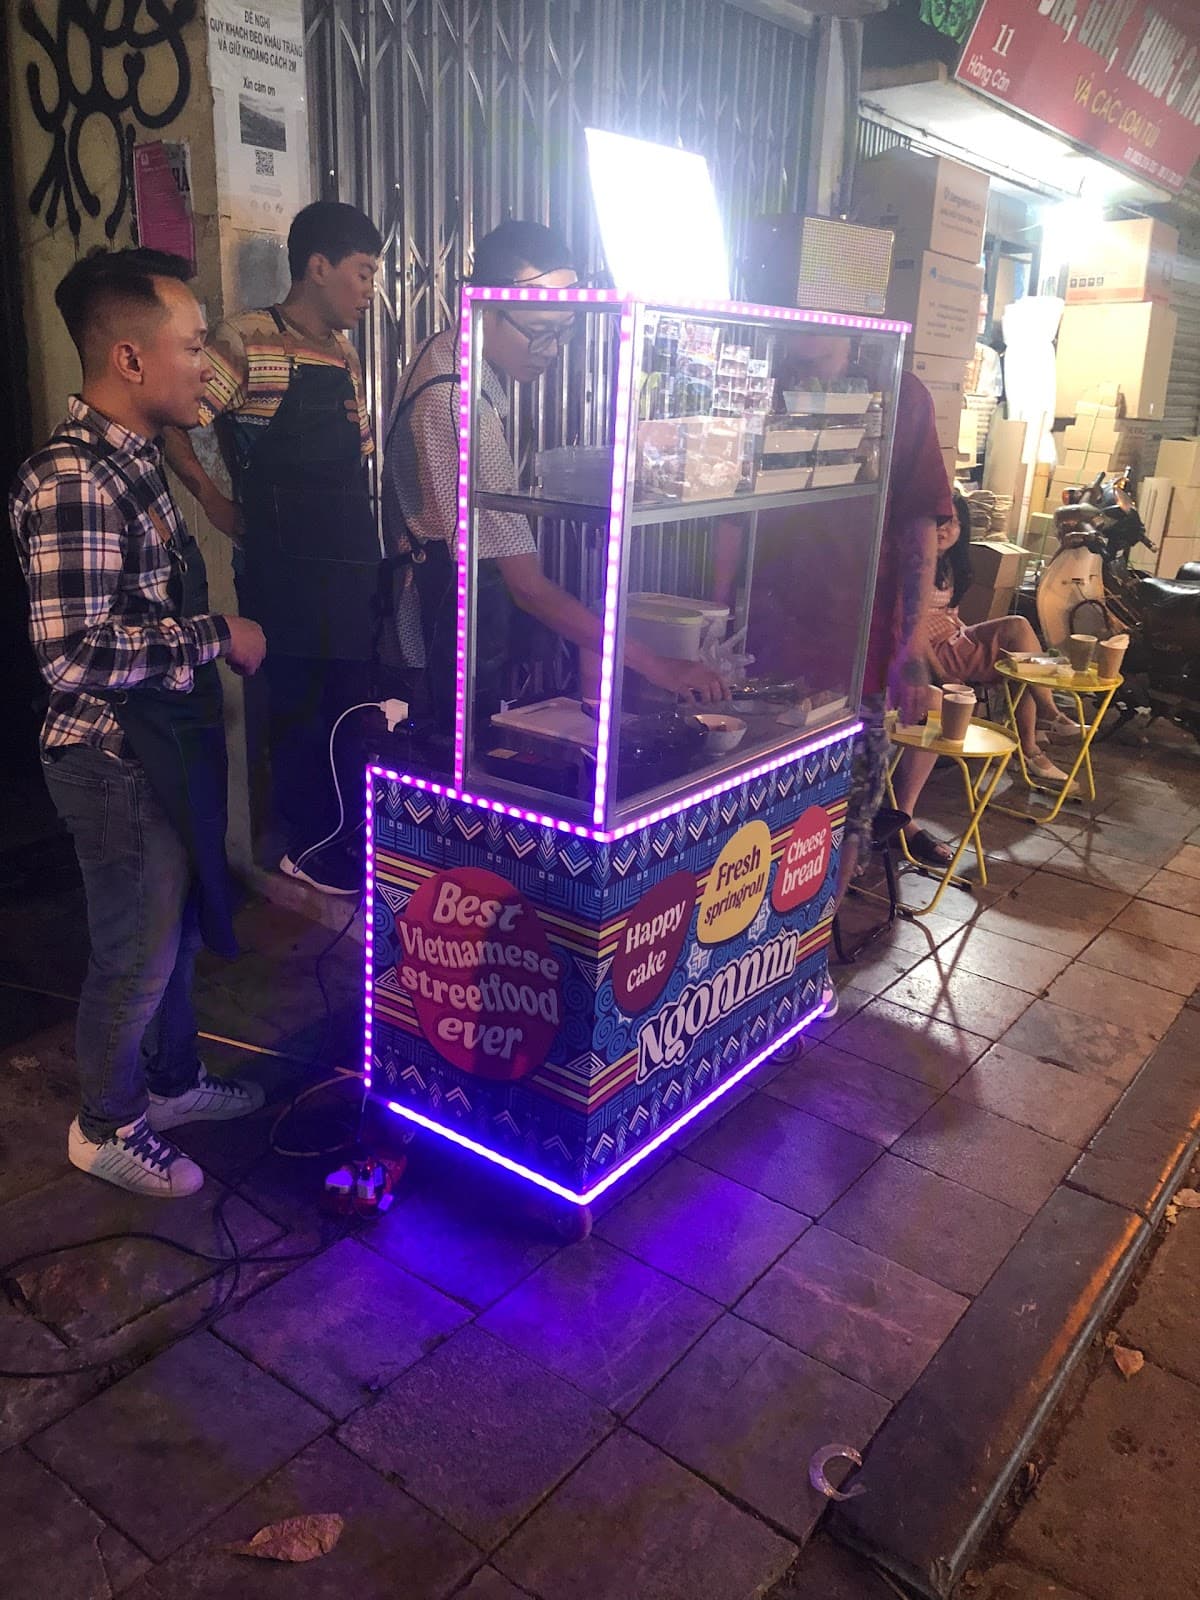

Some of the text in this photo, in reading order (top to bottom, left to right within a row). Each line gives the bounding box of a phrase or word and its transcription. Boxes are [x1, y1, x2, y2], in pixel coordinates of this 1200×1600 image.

[282, 39, 303, 57] TRANG
[991, 24, 1016, 57] 11
[243, 76, 253, 90] Xin
[288, 59, 297, 73] 2M
[966, 54, 993, 87] Hàng
[1073, 71, 1095, 107] VÀ
[1091, 88, 1121, 124] CÁC
[715, 844, 761, 892] Fresh
[786, 827, 828, 866] Cheese
[781, 853, 825, 898] bread
[432, 881, 524, 931] Best
[703, 871, 765, 927] springroll
[625, 899, 687, 954] Happy
[399, 920, 561, 981] Vietnamese
[626, 947, 668, 993] cake
[400, 965, 560, 1026] streetfood
[437, 1016, 524, 1060] ever
